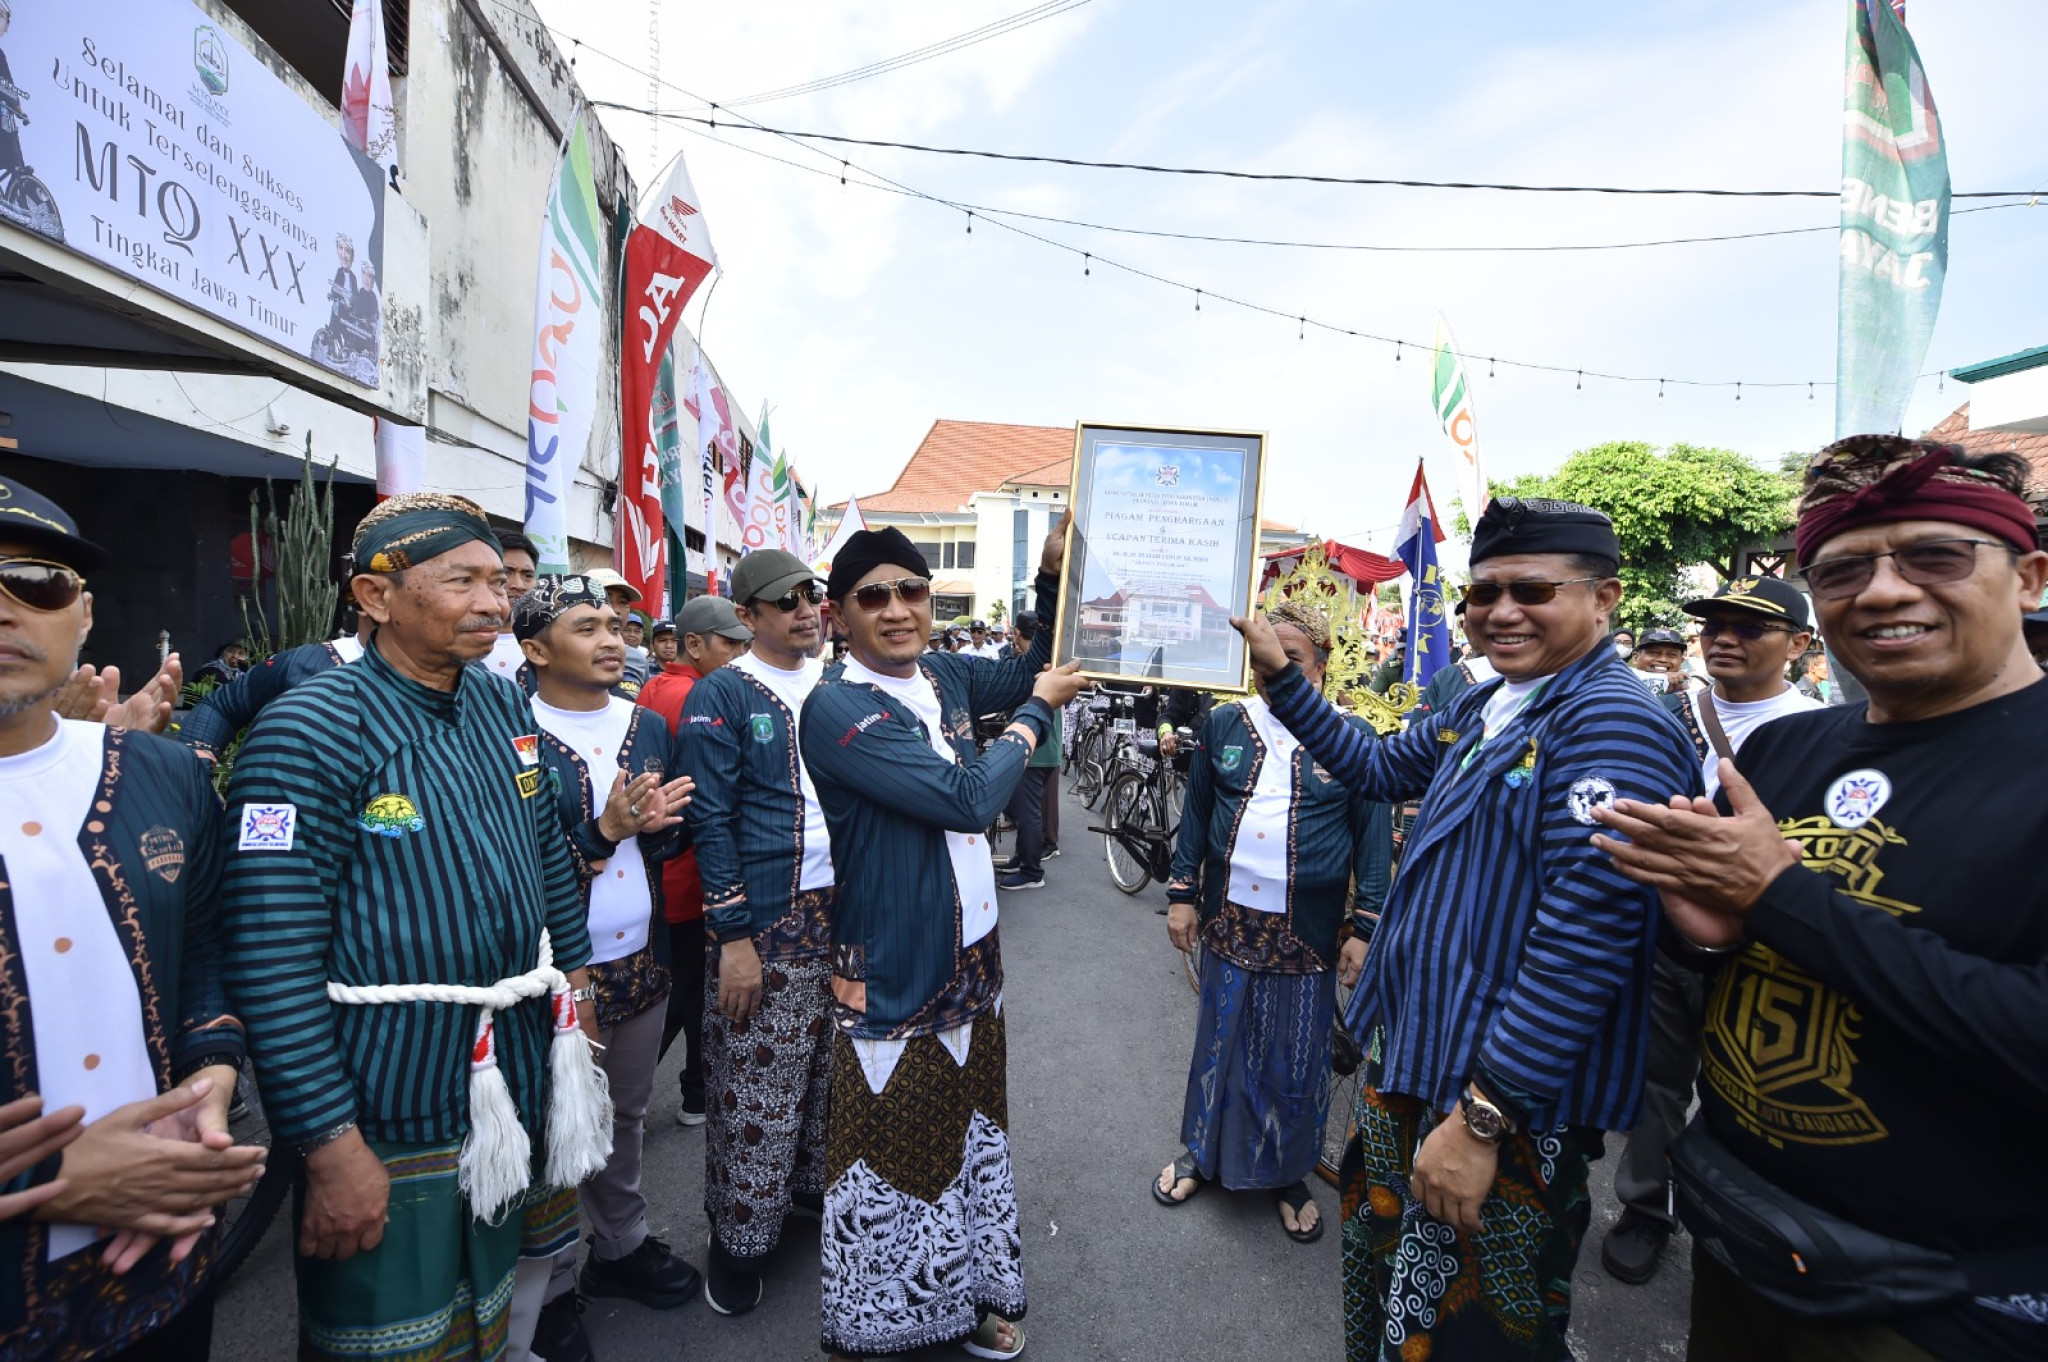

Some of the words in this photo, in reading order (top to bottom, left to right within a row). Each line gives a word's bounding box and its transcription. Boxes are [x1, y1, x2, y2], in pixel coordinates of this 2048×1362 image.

[53, 57, 130, 132] Untuk
[144, 118, 319, 253] Terselenggaranya
[82, 37, 184, 131] Selamat
[197, 124, 234, 164] dan
[242, 154, 304, 213] Sukses
[74, 119, 201, 258] MTQ
[227, 214, 306, 305] XXX
[90, 215, 181, 281] Tingkat
[191, 268, 238, 309] Jawa
[247, 295, 298, 337] Timur
[1104, 511, 1144, 521] PIAGAM
[1149, 514, 1225, 527] PENGHARGAAN
[1106, 532, 1145, 542] UCAPAN
[1147, 535, 1185, 545] TERIMA
[1188, 538, 1220, 548] KASIH
[1801, 836, 1877, 866] KOTI
[1792, 1112, 1871, 1133] SAUDARA
